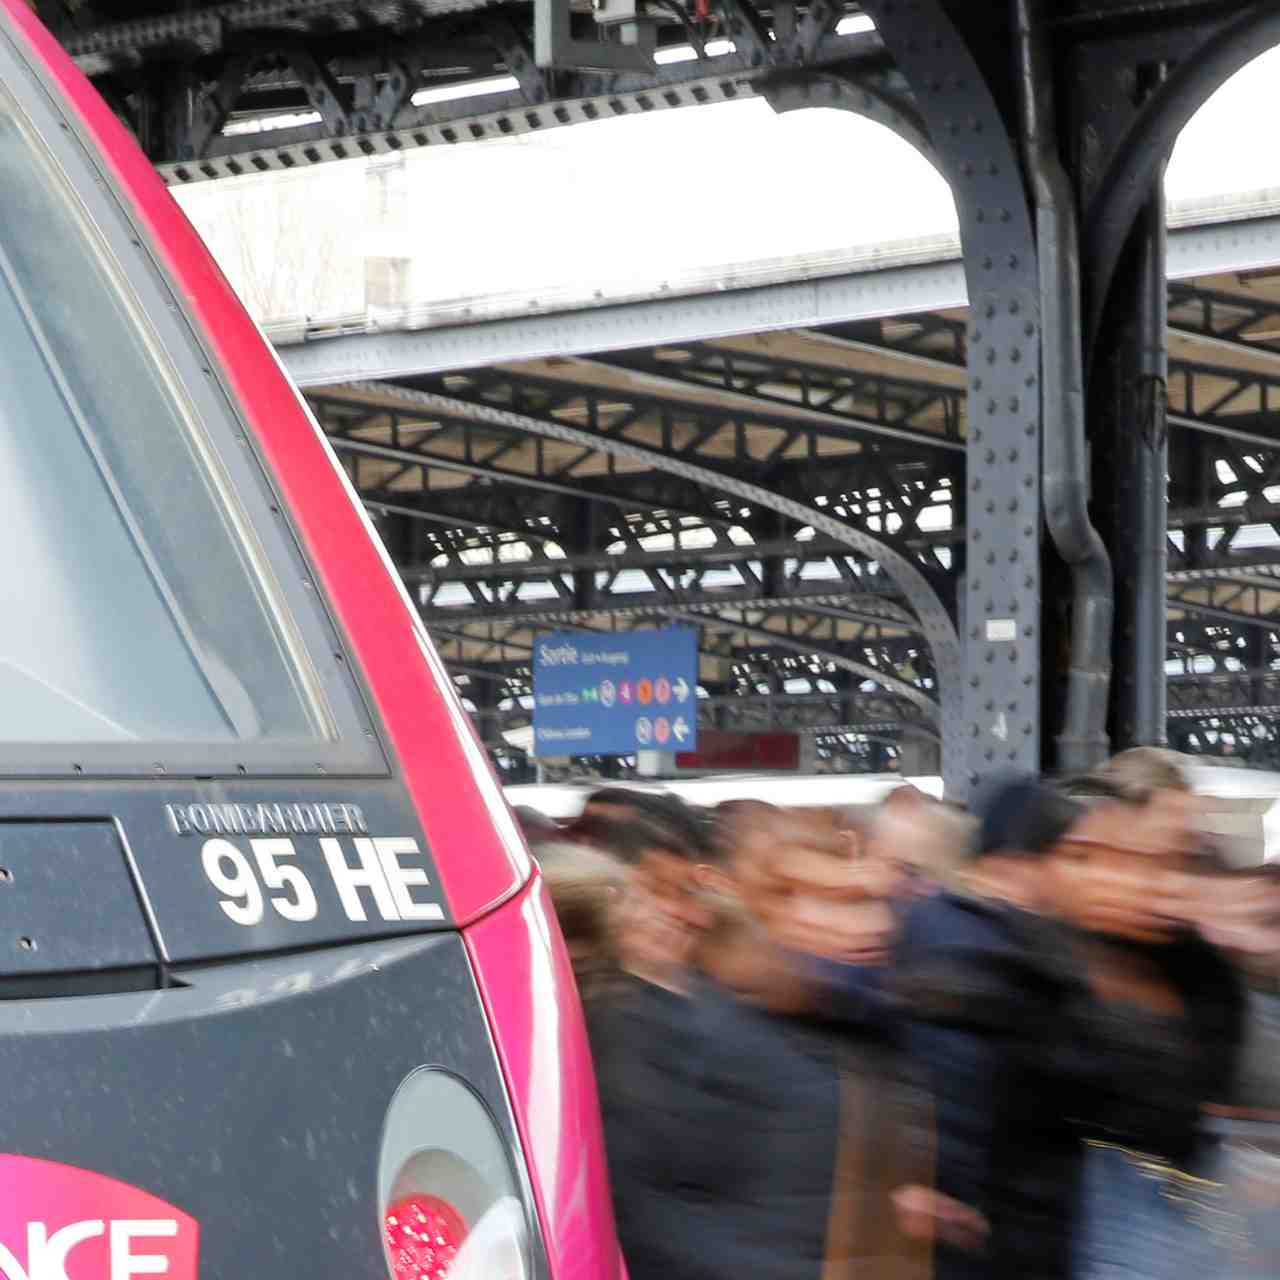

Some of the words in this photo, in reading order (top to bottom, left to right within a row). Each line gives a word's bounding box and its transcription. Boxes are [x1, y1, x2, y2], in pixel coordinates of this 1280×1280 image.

[166, 803, 369, 835] BOMBARDIER
[201, 838, 318, 925] 95
[319, 837, 445, 922] HE
